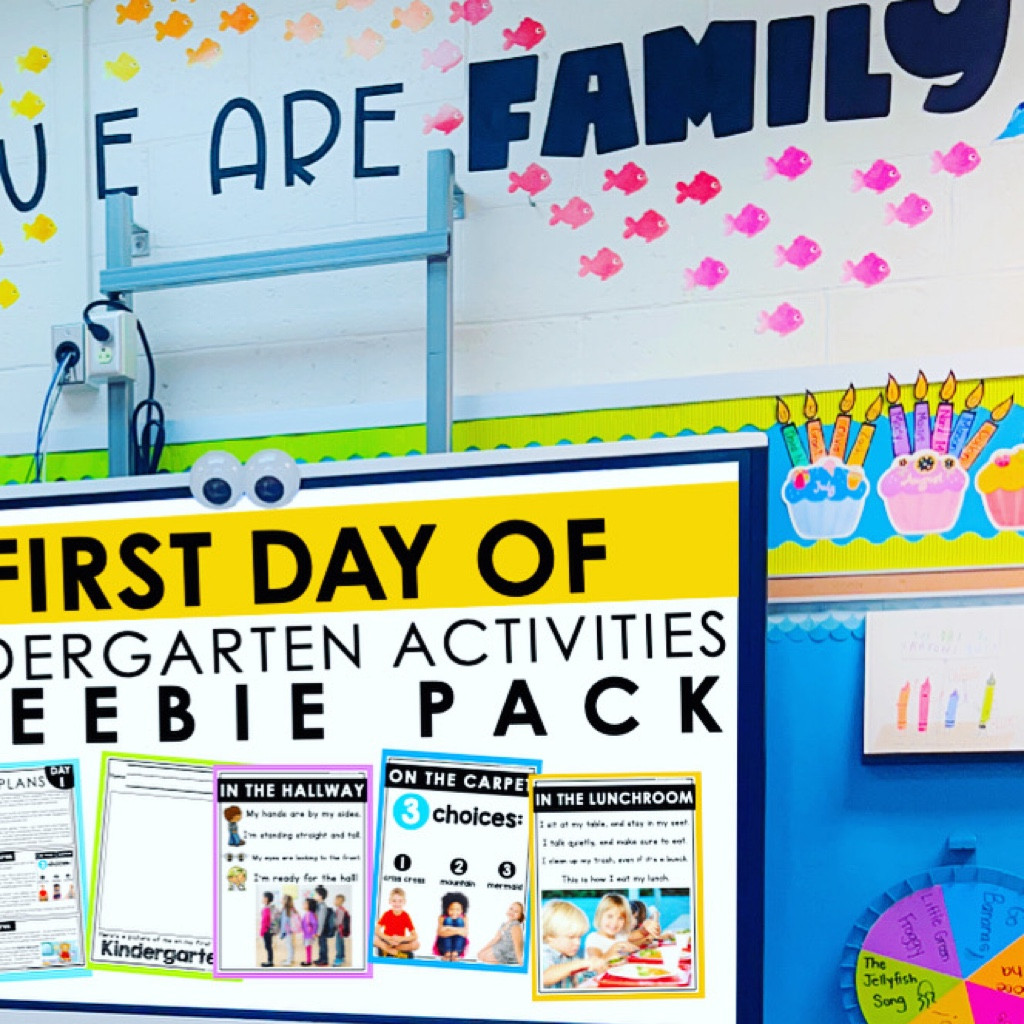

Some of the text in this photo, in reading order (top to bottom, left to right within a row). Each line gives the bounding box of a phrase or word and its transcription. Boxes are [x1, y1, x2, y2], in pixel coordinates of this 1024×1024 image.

[211, 82, 404, 195] ARE
[251, 524, 438, 605] DAY
[477, 517, 607, 597] OF
[393, 610, 726, 668] ACTIVITIES
[420, 676, 723, 737] PACK
[50, 765, 71, 776] DAY
[389, 769, 529, 791] ON THE CARPE
[220, 783, 365, 798] IN THE HALLWAY
[536, 790, 694, 806] IN THE LUNCHROOM
[246, 810, 259, 819] My
[261, 810, 287, 818] hands
[307, 810, 319, 819] by
[321, 811, 334, 819] my
[401, 797, 524, 829] 3 choices:
[260, 831, 293, 841] standing
[296, 831, 328, 841] straight
[330, 831, 345, 839] and
[272, 873, 300, 883] ready
[303, 873, 318, 882] for
[321, 873, 337, 882] the
[562, 875, 579, 883] This
[864, 957, 886, 970] The
[863, 971, 919, 990] Jellyfish
[873, 994, 908, 1013] Song
